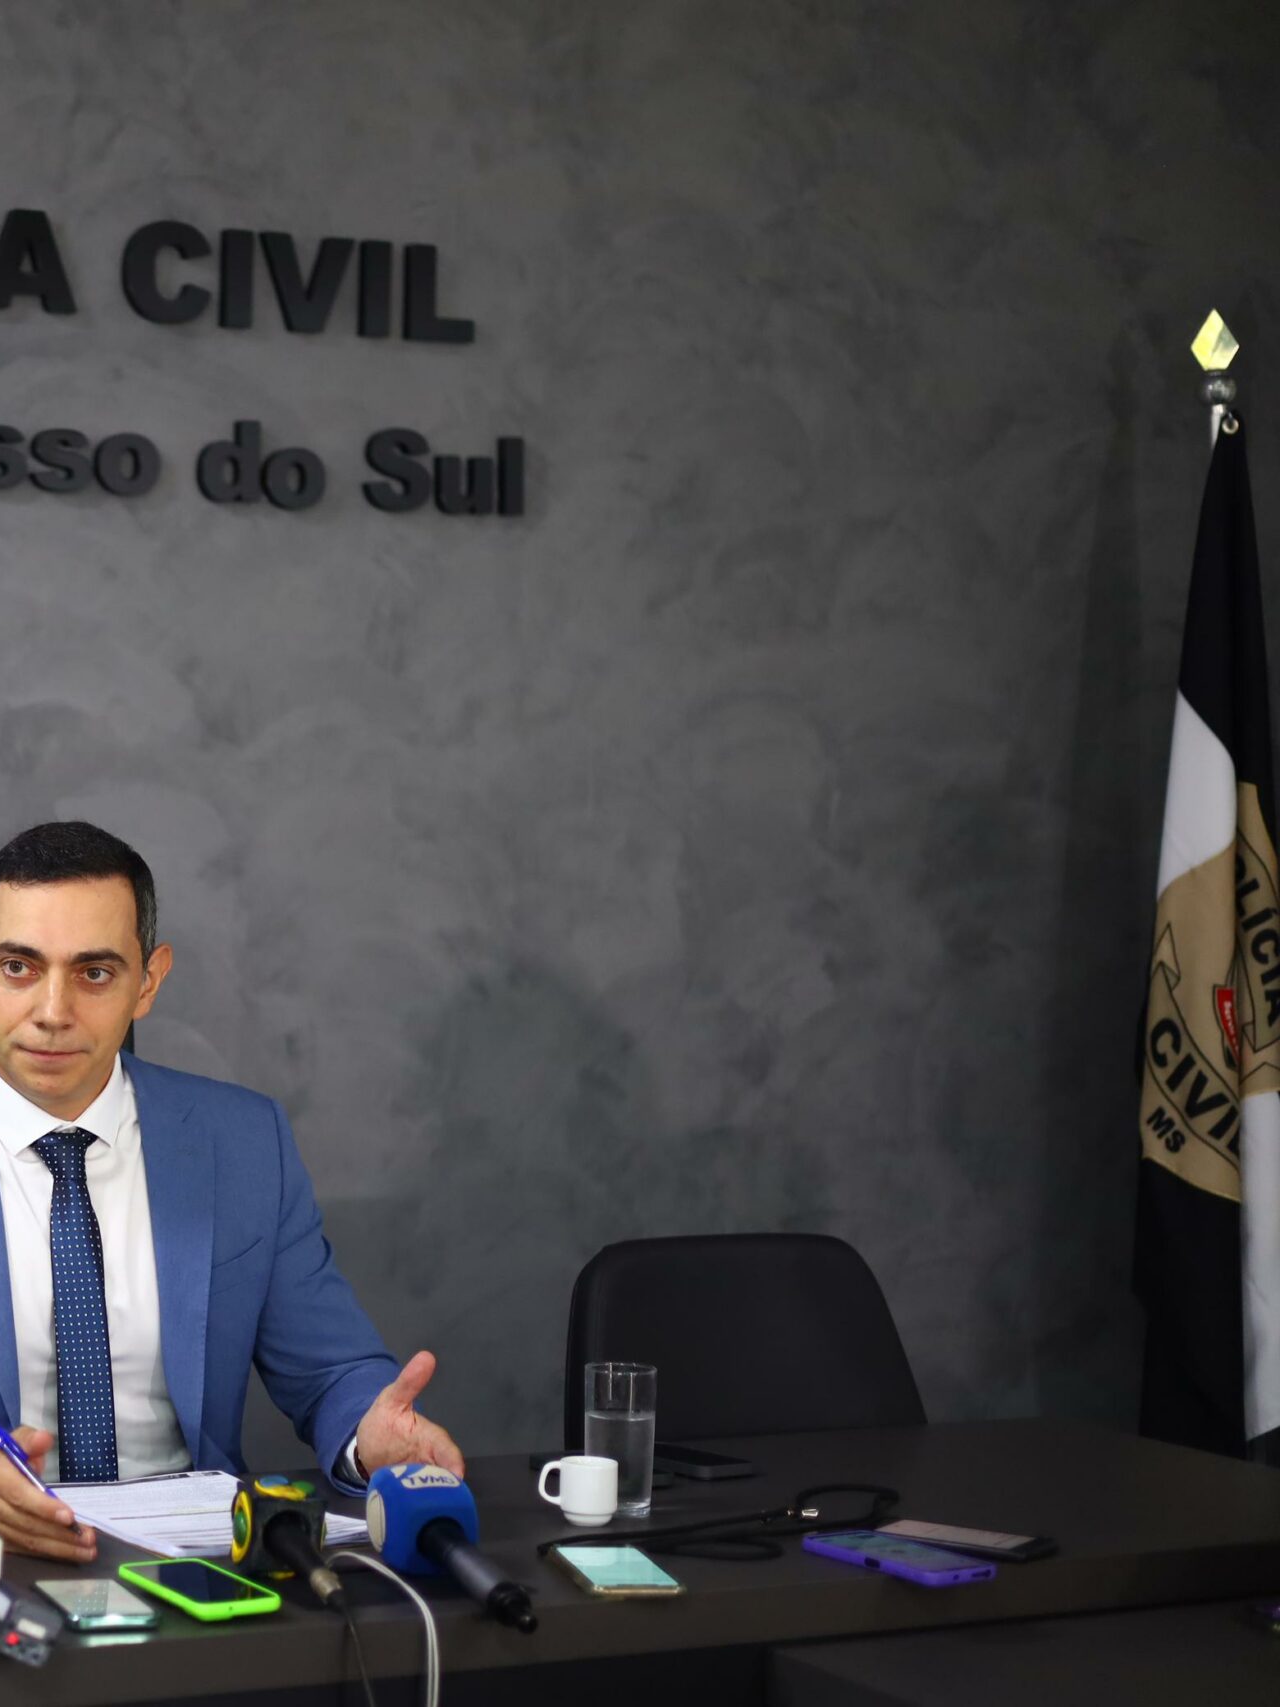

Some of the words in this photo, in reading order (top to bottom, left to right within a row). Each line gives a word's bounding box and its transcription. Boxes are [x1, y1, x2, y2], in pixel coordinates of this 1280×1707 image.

[122, 220, 475, 344] CIVIL
[196, 420, 325, 511] do
[361, 428, 525, 518] Sul
[1147, 1106, 1185, 1154] MS
